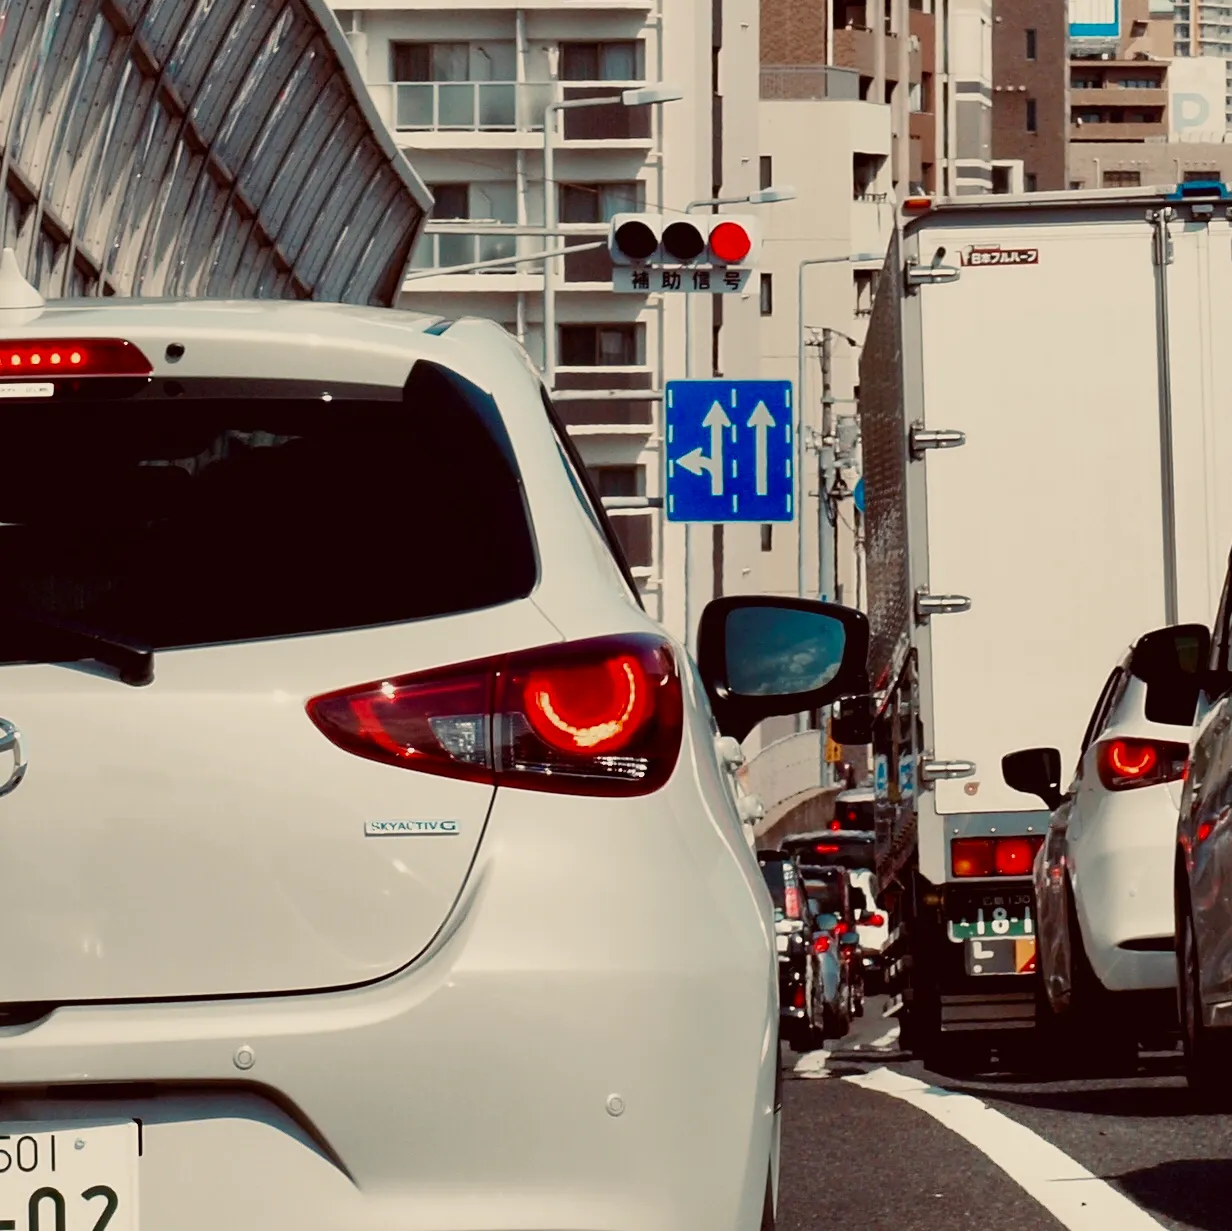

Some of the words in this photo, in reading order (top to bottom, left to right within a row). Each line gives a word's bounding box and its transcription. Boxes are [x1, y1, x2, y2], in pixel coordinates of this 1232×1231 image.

[971, 250, 1038, 265] 日本フルハーフ
[632, 270, 742, 290] 補助信号
